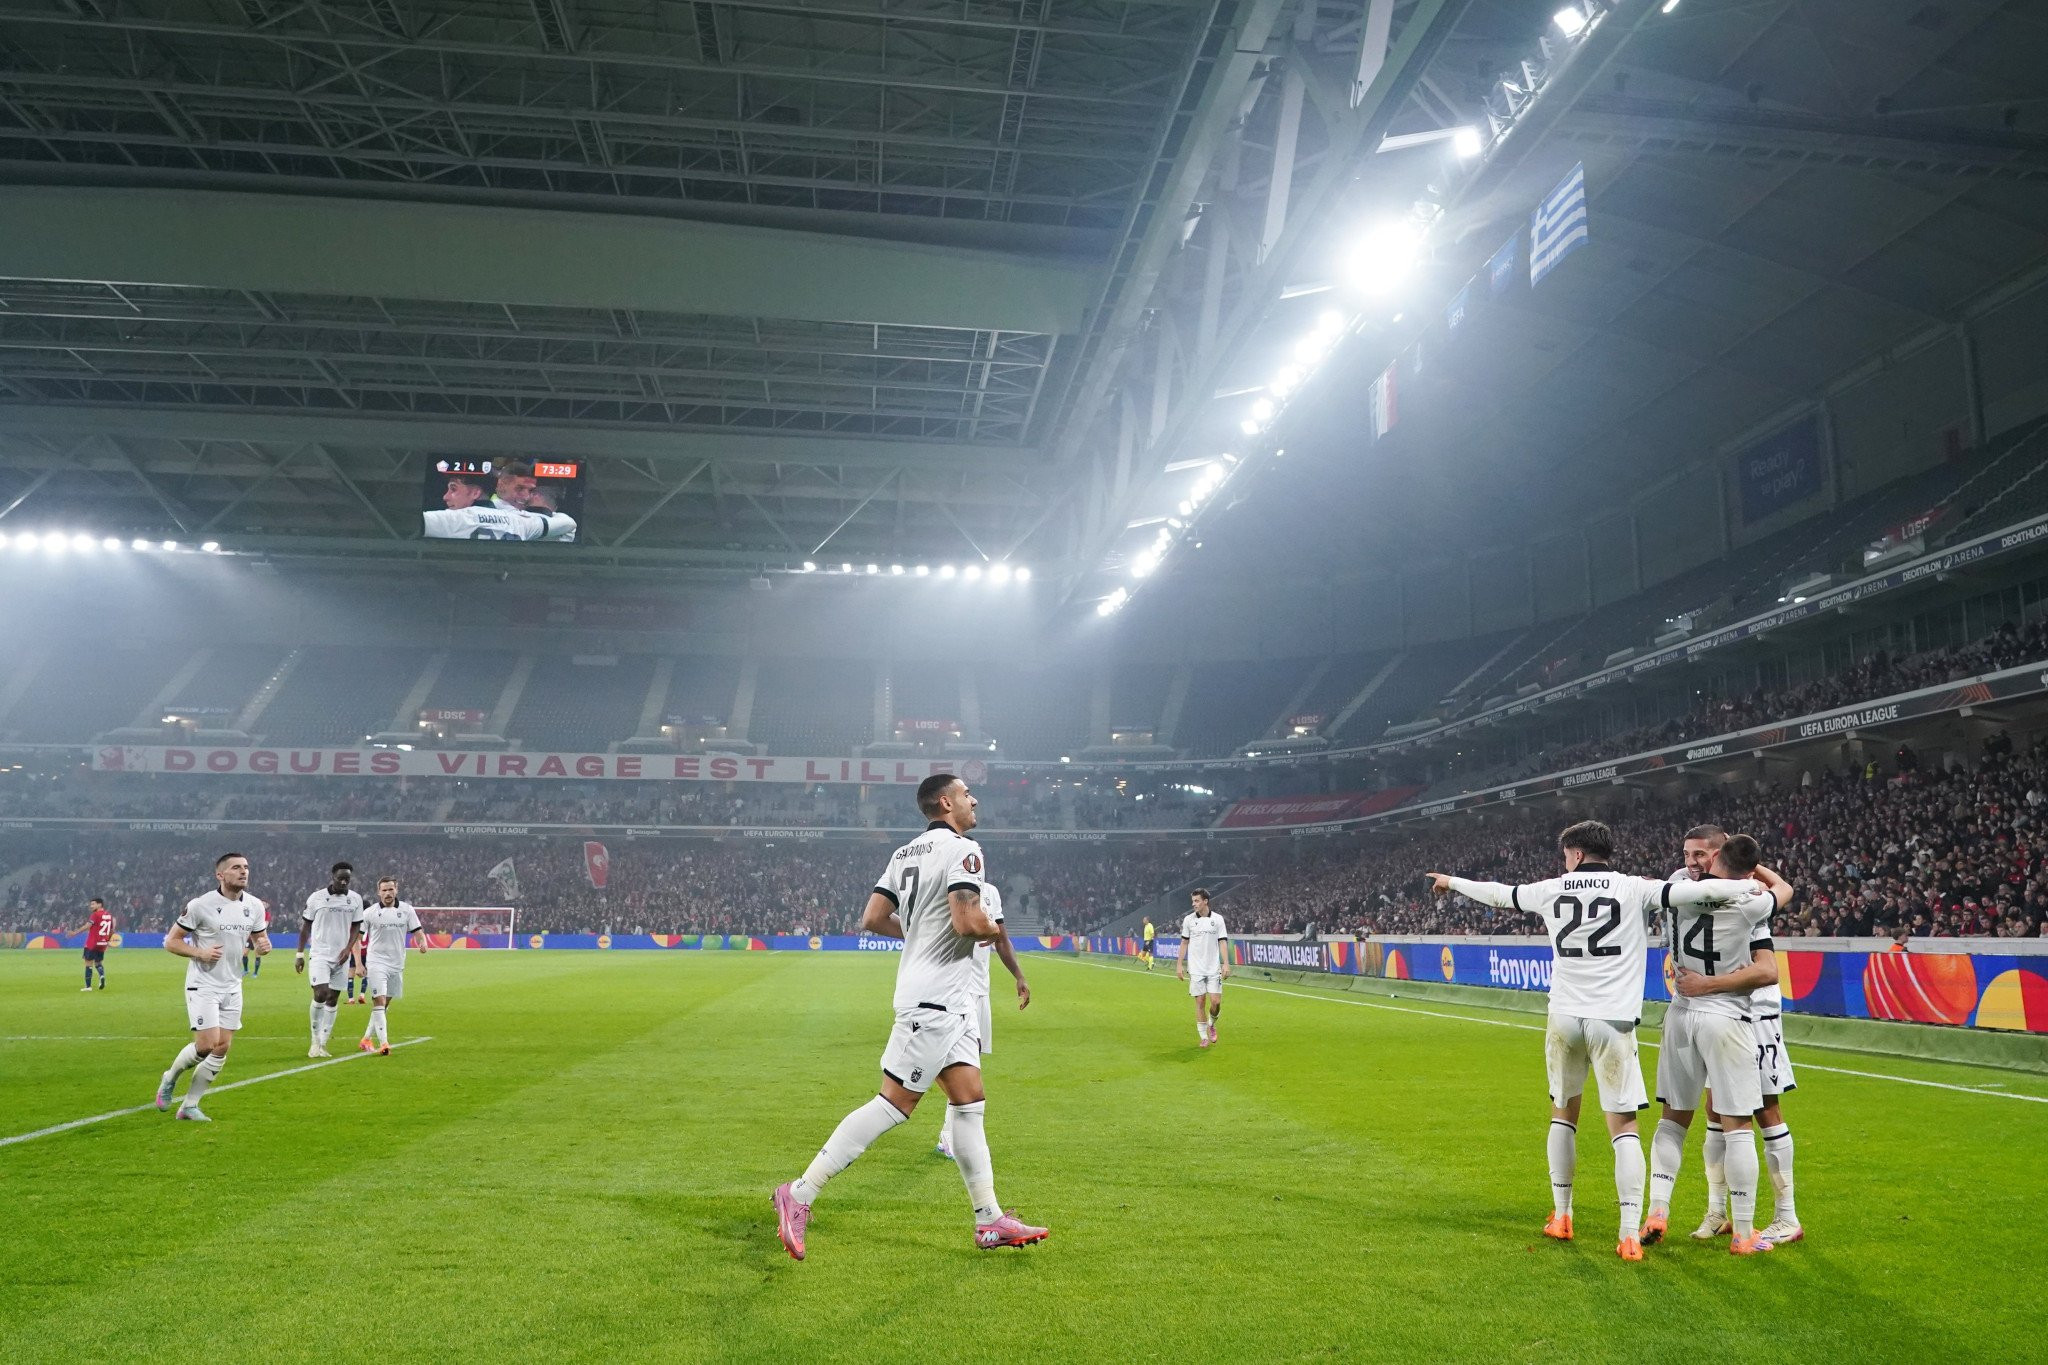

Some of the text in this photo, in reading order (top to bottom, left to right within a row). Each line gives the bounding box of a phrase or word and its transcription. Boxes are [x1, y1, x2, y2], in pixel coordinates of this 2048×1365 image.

[453, 462, 475, 472] 2 4
[542, 465, 572, 475] 73:29
[1750, 450, 1790, 478] Ready
[1773, 458, 1805, 497] play?
[1900, 516, 1931, 540] LOSC
[2001, 523, 2048, 549] DECATHLON
[1902, 545, 1985, 583] DECATHLON ARENA
[1819, 578, 1889, 609] DECATHLON ARENA
[1783, 607, 1808, 621] ARENA
[437, 710, 466, 720] LOSC
[1799, 705, 1898, 738] UEFA EUROPA LEAGUE
[164, 749, 954, 783] DOGUES VIRAGE EST LILLE
[1562, 766, 1617, 787] UEFA EUROPA LEAGUE
[443, 826, 465, 834] UEFA
[743, 830, 763, 838] UEFA
[1029, 832, 1049, 840] UEFA
[1563, 878, 1611, 891] BIANCO
[899, 866, 920, 932] 7
[98, 920, 112, 936] 21
[1553, 894, 1622, 958] 22
[1669, 907, 1721, 976] 14
[1252, 943, 1320, 967] UEFA EUROPA LEAGUE
[1489, 949, 1554, 989] #onyou
[1757, 1044, 1778, 1070] 77
